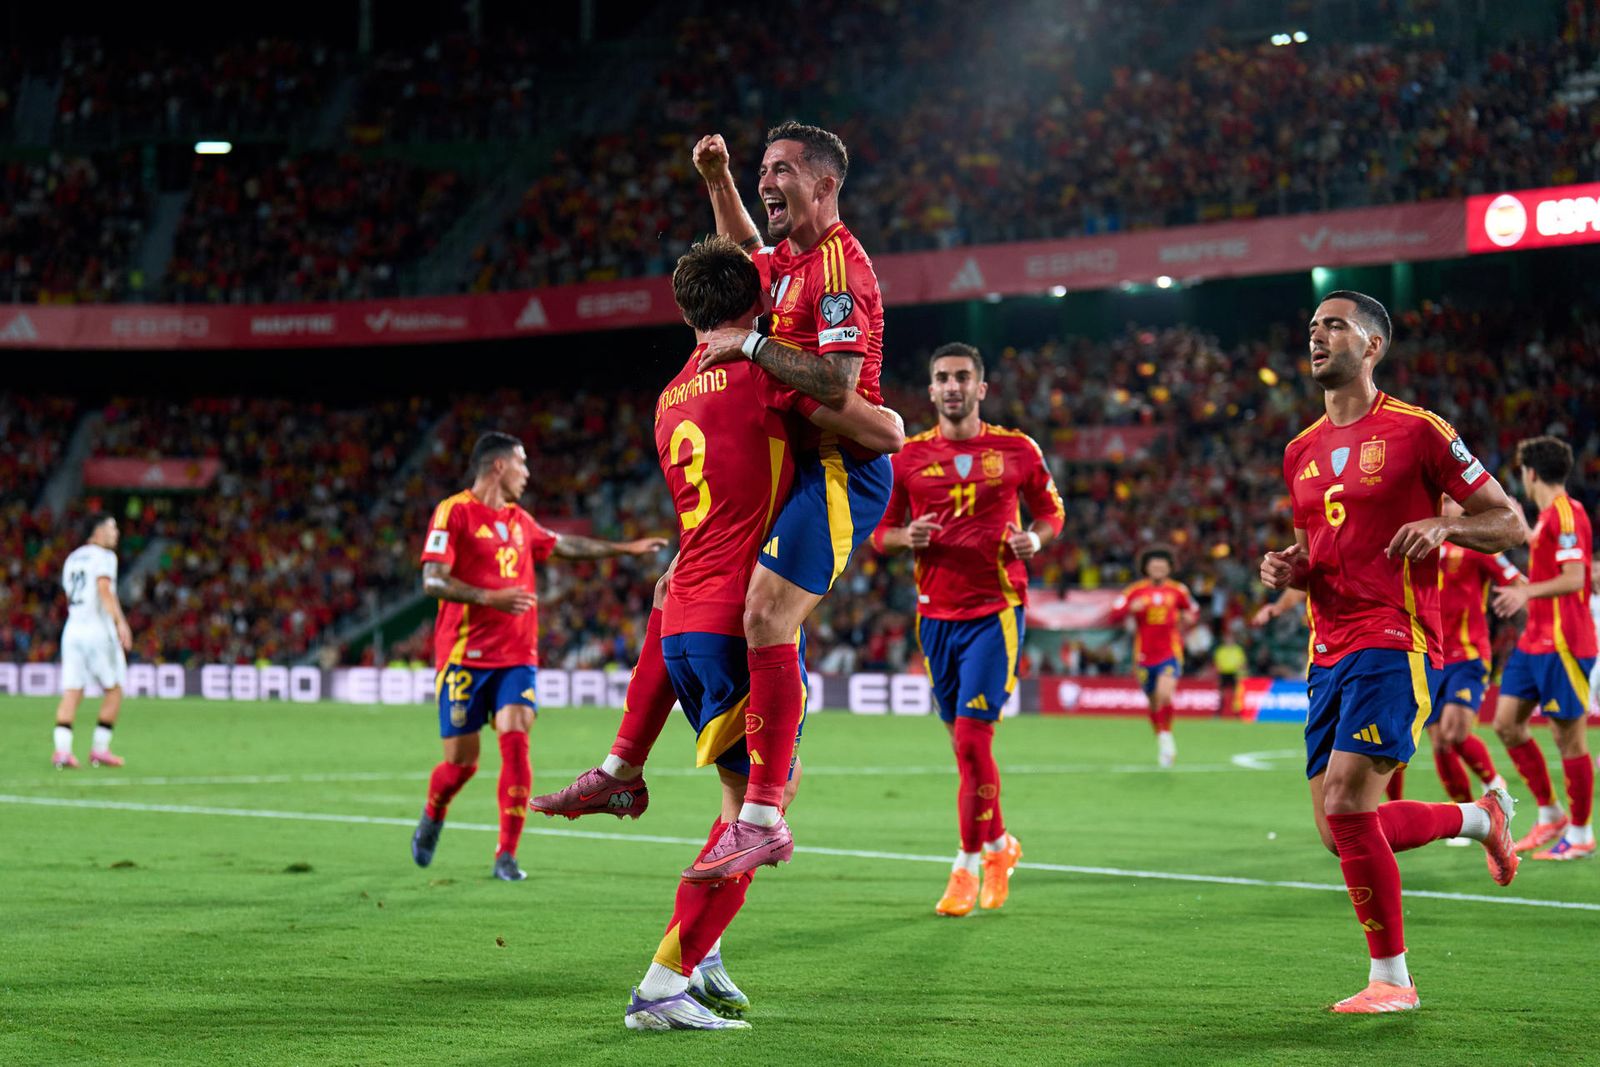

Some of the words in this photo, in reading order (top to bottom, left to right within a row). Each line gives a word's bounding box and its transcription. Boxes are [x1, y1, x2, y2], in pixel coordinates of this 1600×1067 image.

[1537, 196, 1600, 236] ESP
[670, 420, 712, 530] 3
[949, 482, 977, 517] 11
[1324, 484, 1346, 527] 6
[495, 547, 519, 578] 12
[446, 670, 473, 702] 12
